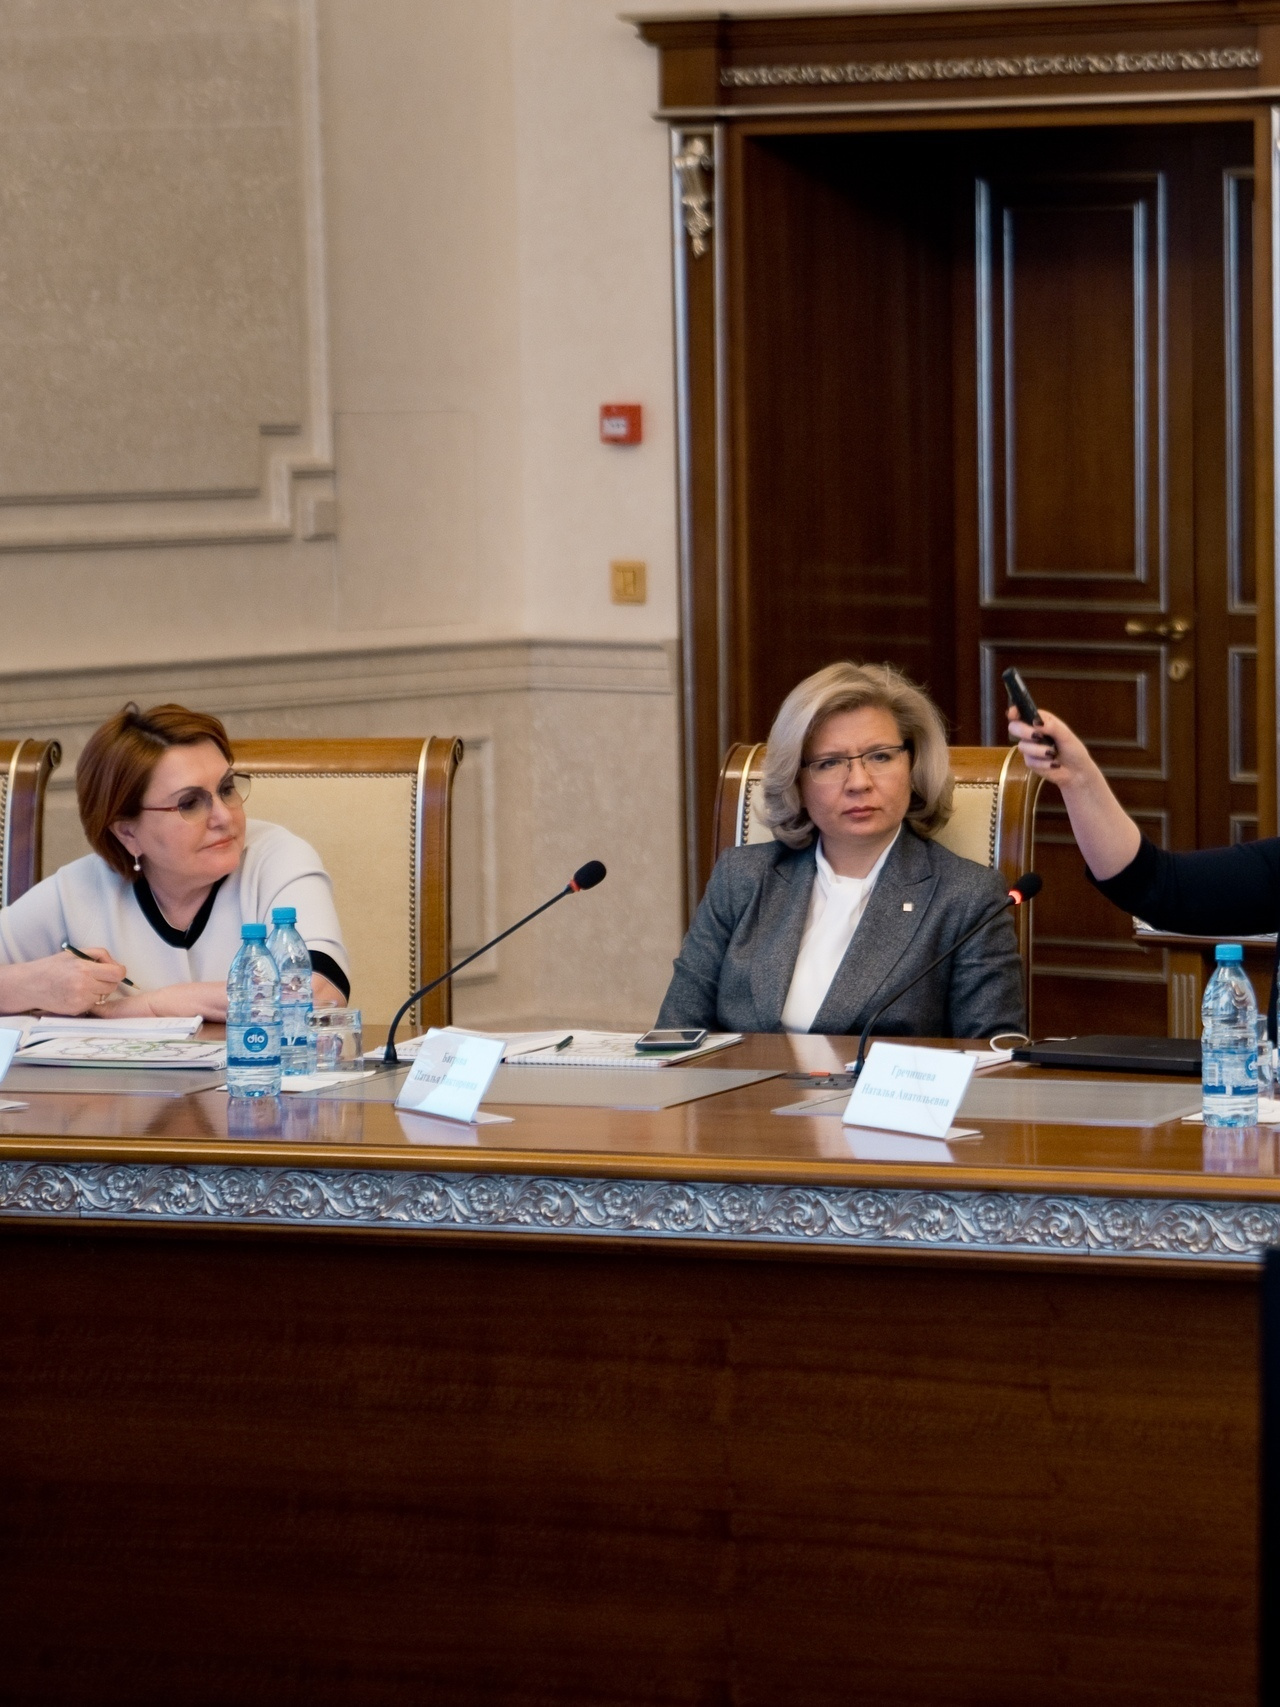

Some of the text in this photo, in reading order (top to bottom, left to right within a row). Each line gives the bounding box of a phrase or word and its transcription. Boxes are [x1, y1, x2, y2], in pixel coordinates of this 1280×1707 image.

[246, 1033, 265, 1044] dio
[414, 1069, 441, 1084] Наталья
[861, 1083, 950, 1107] Наталья Анатольевна
